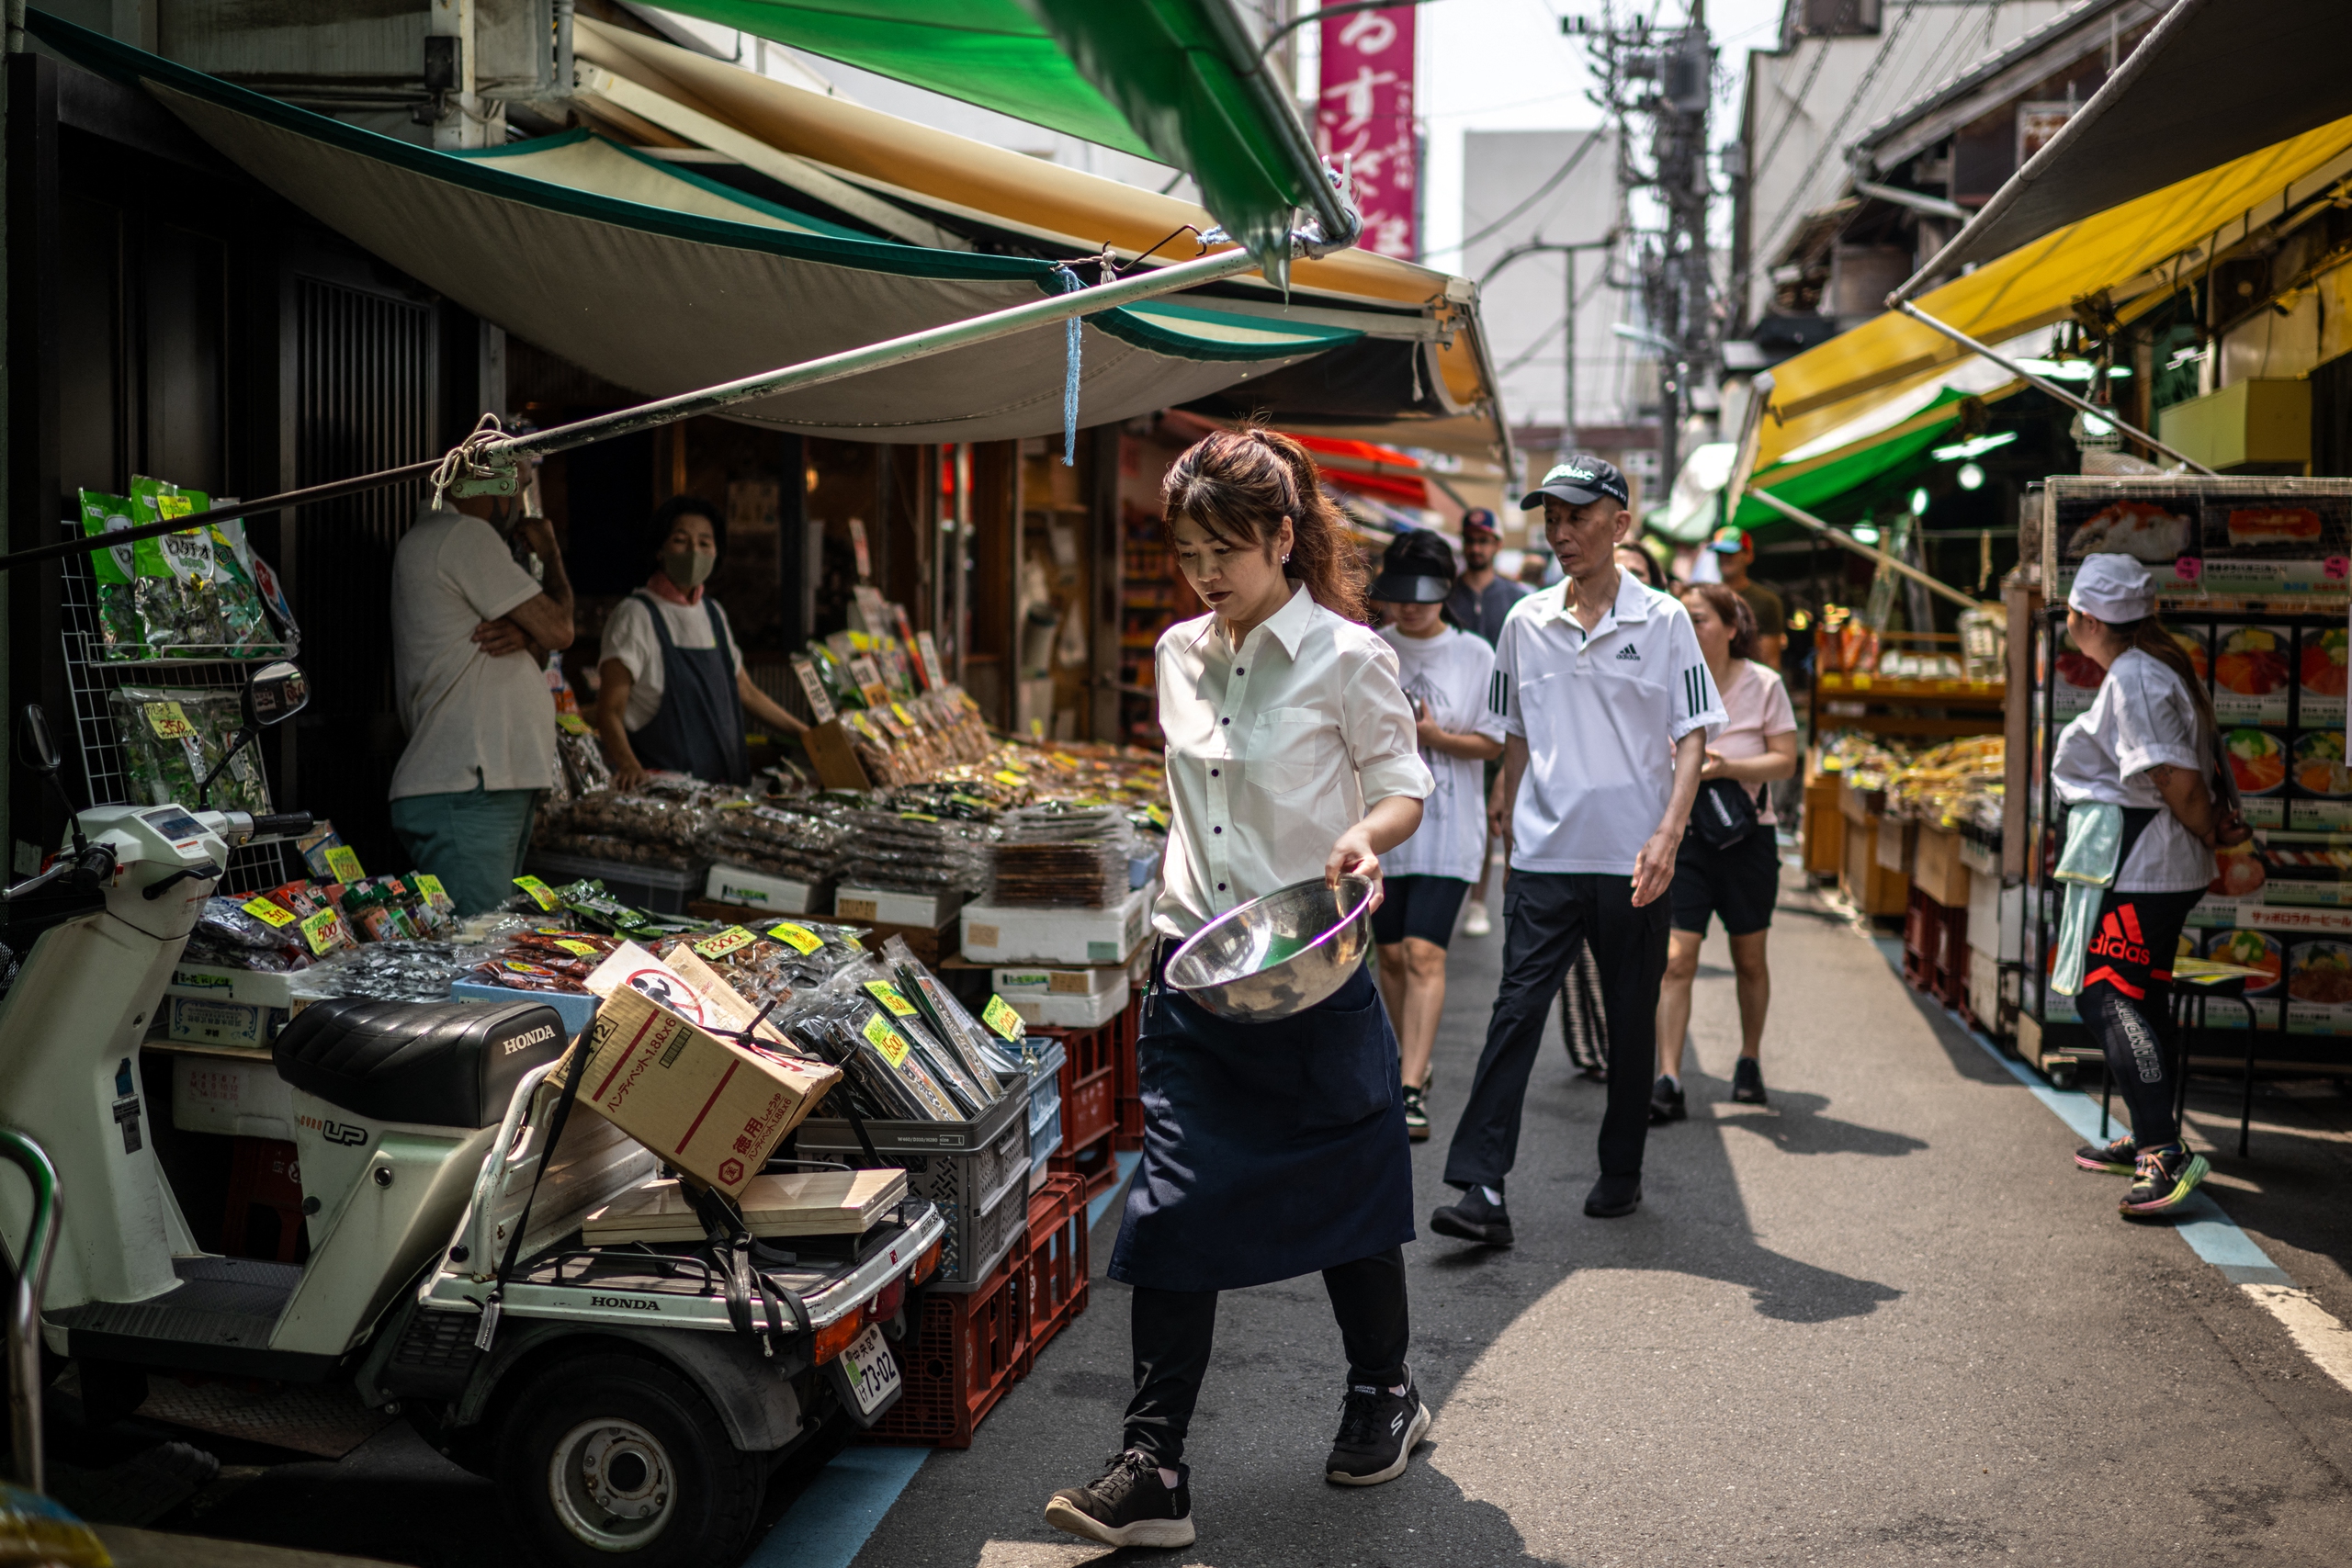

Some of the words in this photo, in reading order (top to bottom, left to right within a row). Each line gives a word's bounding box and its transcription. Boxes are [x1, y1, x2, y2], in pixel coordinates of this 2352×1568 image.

[1616, 653, 1641, 661] adidas
[159, 719, 186, 736] 350
[317, 920, 337, 943] 500
[705, 933, 742, 953] 800
[2088, 931, 2151, 965] didas
[503, 1024, 556, 1055] HONDA
[300, 1115, 322, 1131] GYRO
[591, 1296, 662, 1312] HONDA
[853, 1337, 876, 1362] 中央区
[860, 1351, 897, 1398] 73-02
[857, 1384, 868, 1404] け
